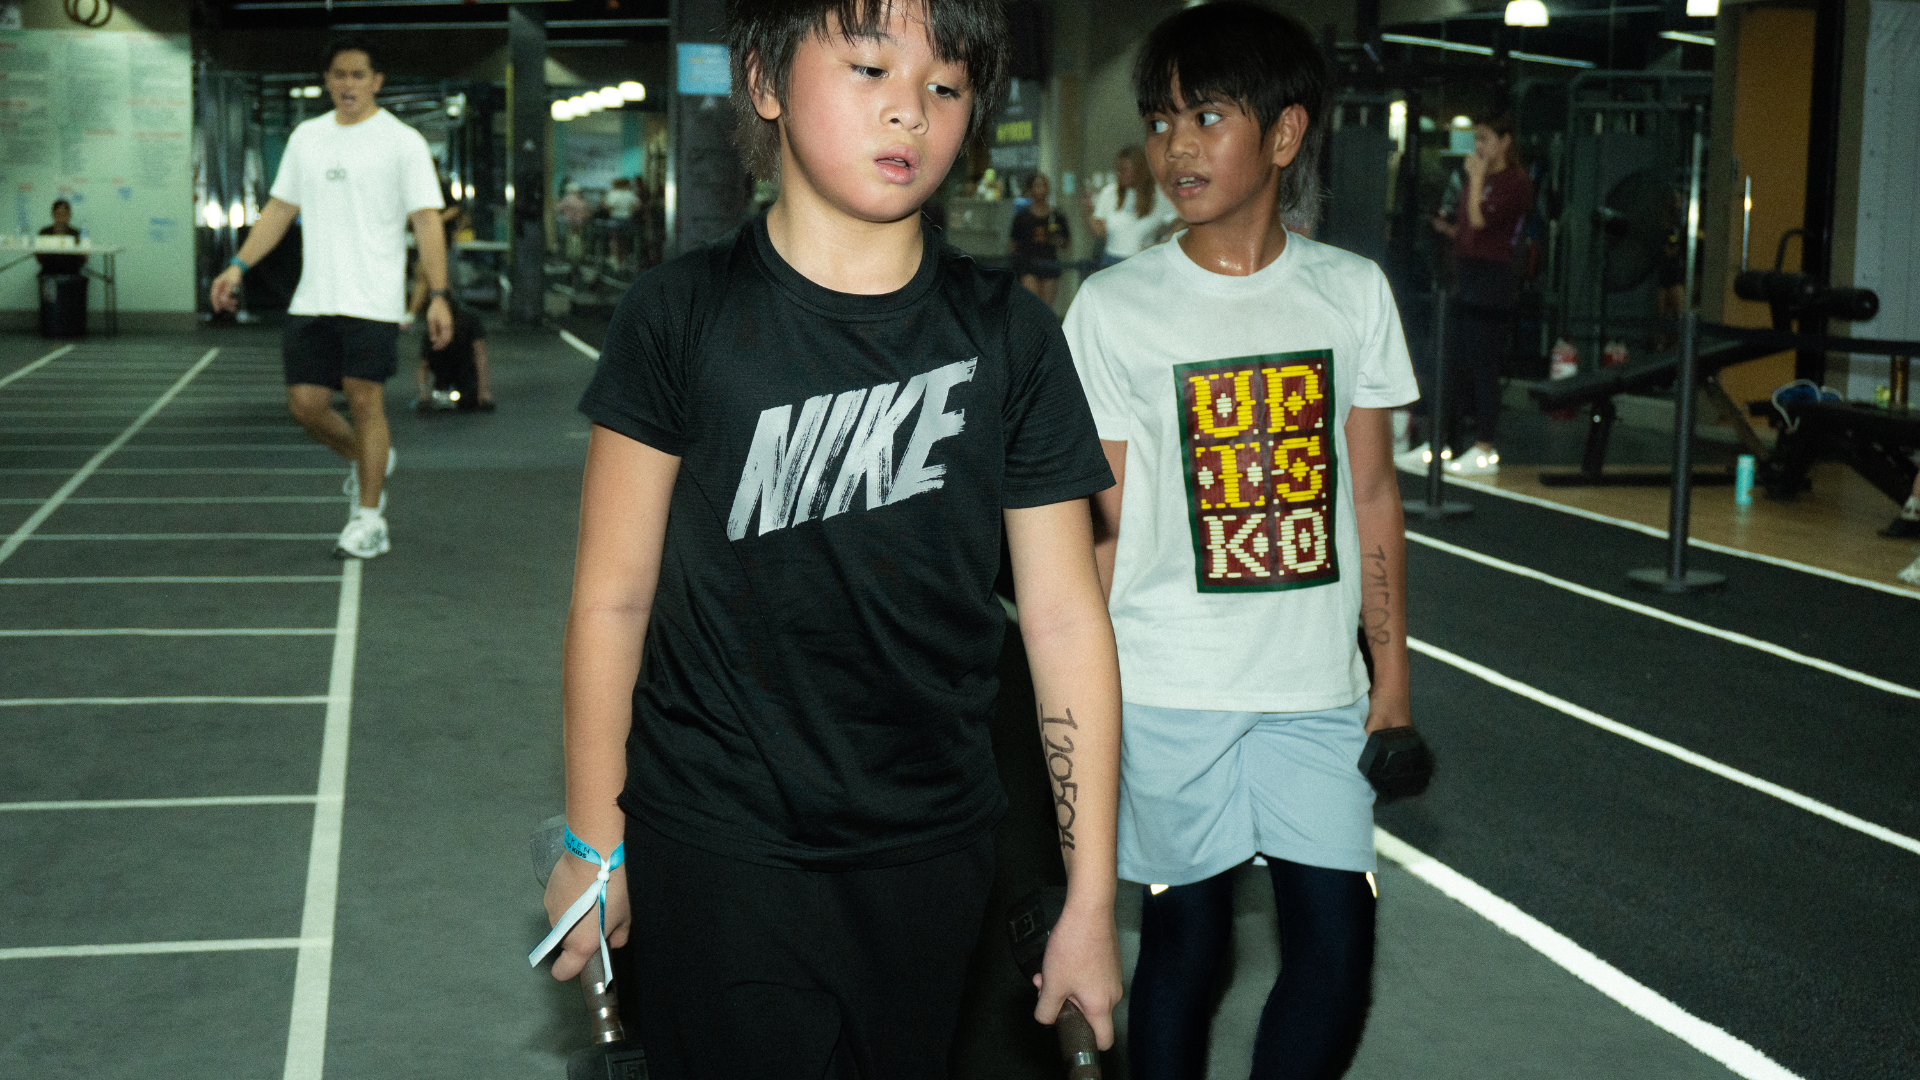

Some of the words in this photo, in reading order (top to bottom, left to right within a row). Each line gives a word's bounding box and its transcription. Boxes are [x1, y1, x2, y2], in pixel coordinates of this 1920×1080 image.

[726, 356, 979, 542] NIKE
[1189, 364, 1323, 438] UP
[1203, 507, 1328, 579] KO
[1039, 702, 1079, 851] 120504
